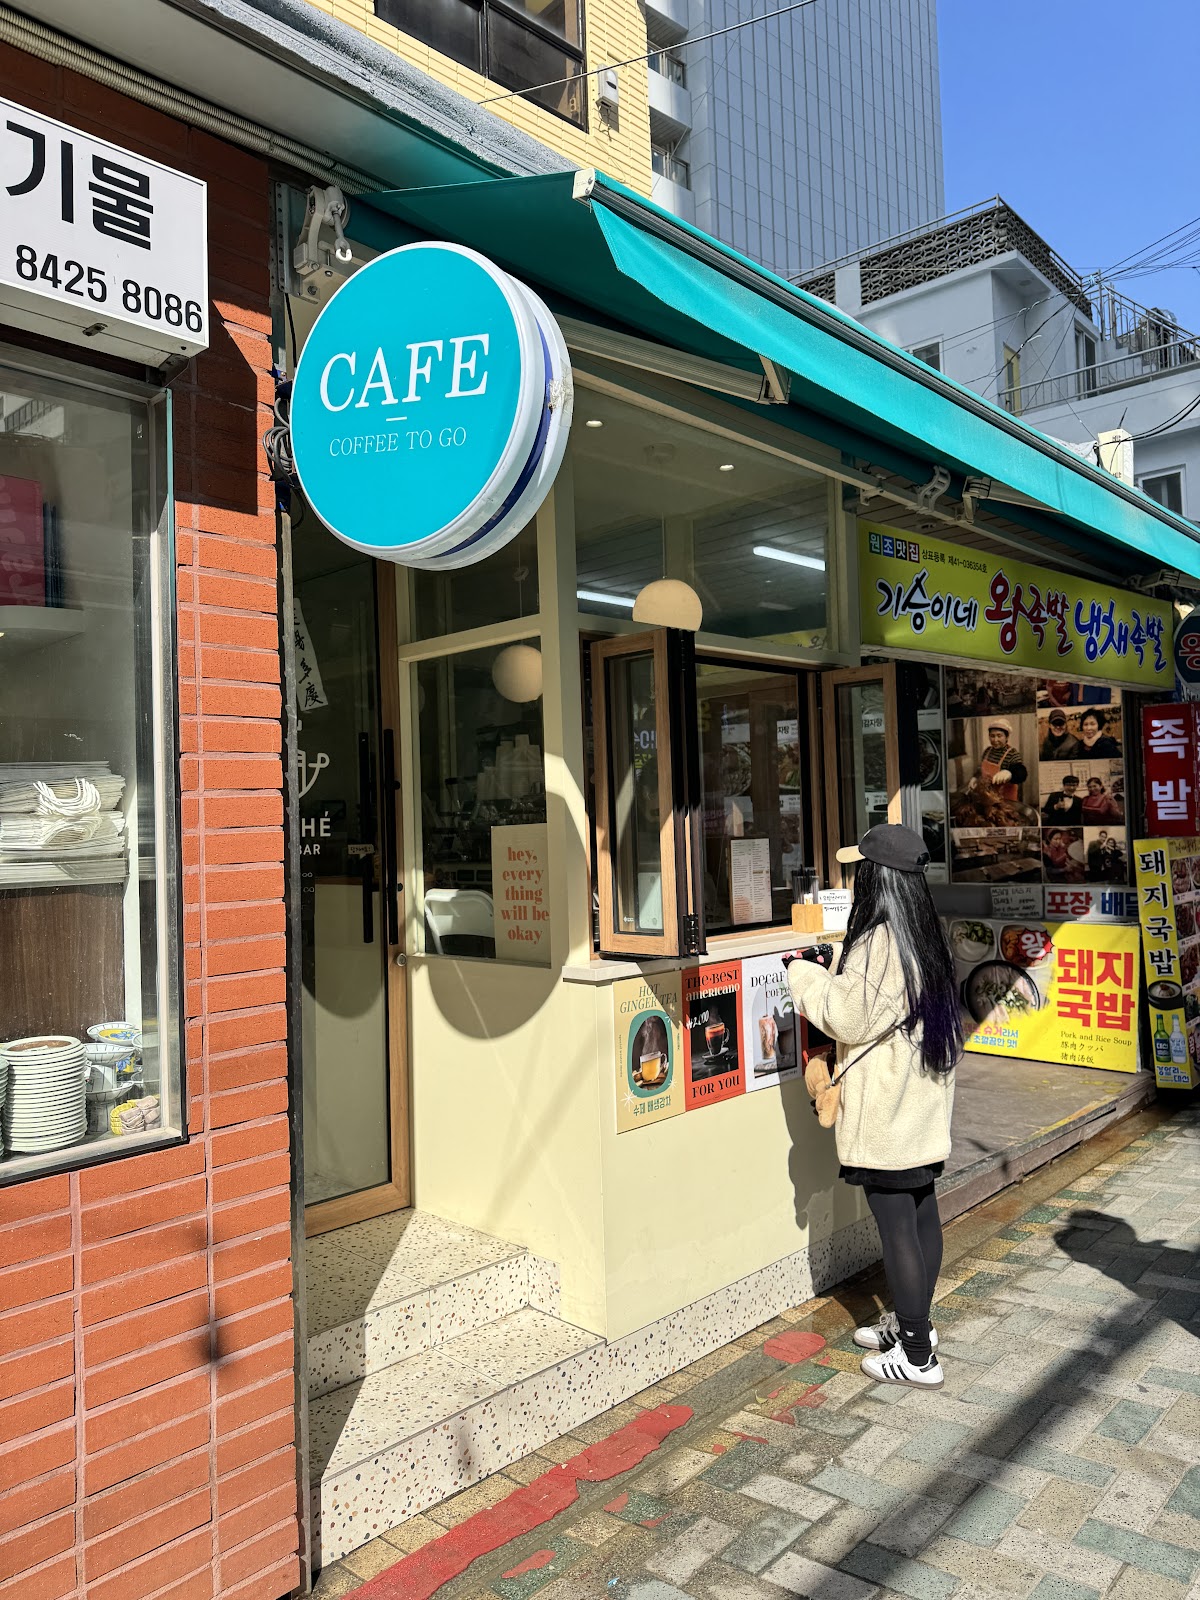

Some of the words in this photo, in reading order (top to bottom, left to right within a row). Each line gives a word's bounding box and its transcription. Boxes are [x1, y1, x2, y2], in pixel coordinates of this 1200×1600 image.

[5, 119, 154, 251] 기물
[15, 244, 108, 303] 8425
[122, 277, 203, 334] 8086
[320, 333, 490, 412] CAFE
[329, 431, 399, 457] COFFEE
[405, 430, 432, 451] TO
[438, 426, 467, 448] GO
[869, 532, 920, 562] 원조맛집
[921, 548, 946, 564] 상표등록
[876, 568, 979, 633] 기승이네
[986, 570, 1074, 655] 왕족발
[1074, 598, 1167, 672] 냉채족발
[301, 810, 331, 838] HÉ
[507, 847, 538, 863] hey,
[502, 869, 544, 886] every
[505, 886, 544, 905] thing
[1047, 891, 1093, 916] 포장
[501, 906, 528, 921] will
[532, 906, 550, 921] be
[1139, 849, 1178, 977] 돼지국밥
[508, 928, 542, 945] okay
[1021, 932, 1045, 958] 왕
[1057, 948, 1133, 990] 돼지
[620, 997, 657, 1014] GINGER
[660, 992, 678, 1006] TEA
[639, 984, 660, 997] HOT
[1057, 988, 1135, 1032] 국밥
[1061, 1030, 1077, 1039] Pork
[1079, 1032, 1093, 1041] and
[1095, 1035, 1111, 1044] Rice
[1113, 1037, 1132, 1046] Soup
[692, 1081, 716, 1098] FOR
[718, 1075, 740, 1091] YOU
